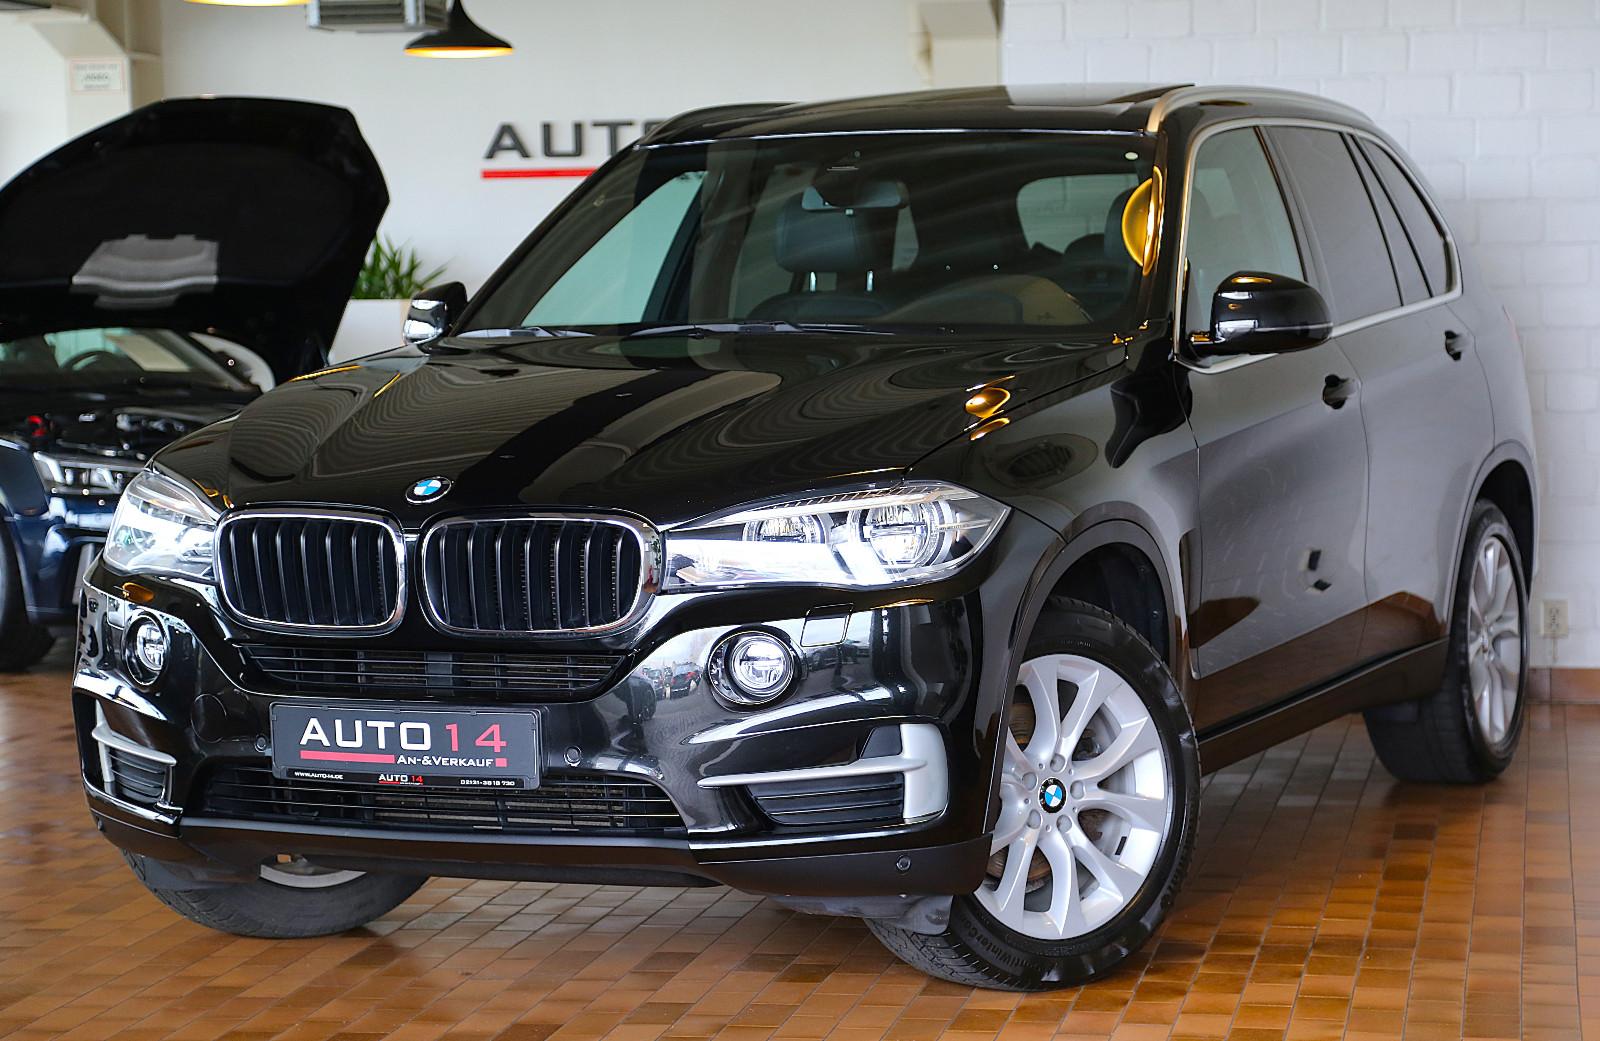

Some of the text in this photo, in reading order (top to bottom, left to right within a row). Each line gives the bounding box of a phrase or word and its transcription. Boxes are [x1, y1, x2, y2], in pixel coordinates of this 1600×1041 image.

[300, 717, 507, 753] AUTO 14
[379, 774, 423, 783] AUTO 14
